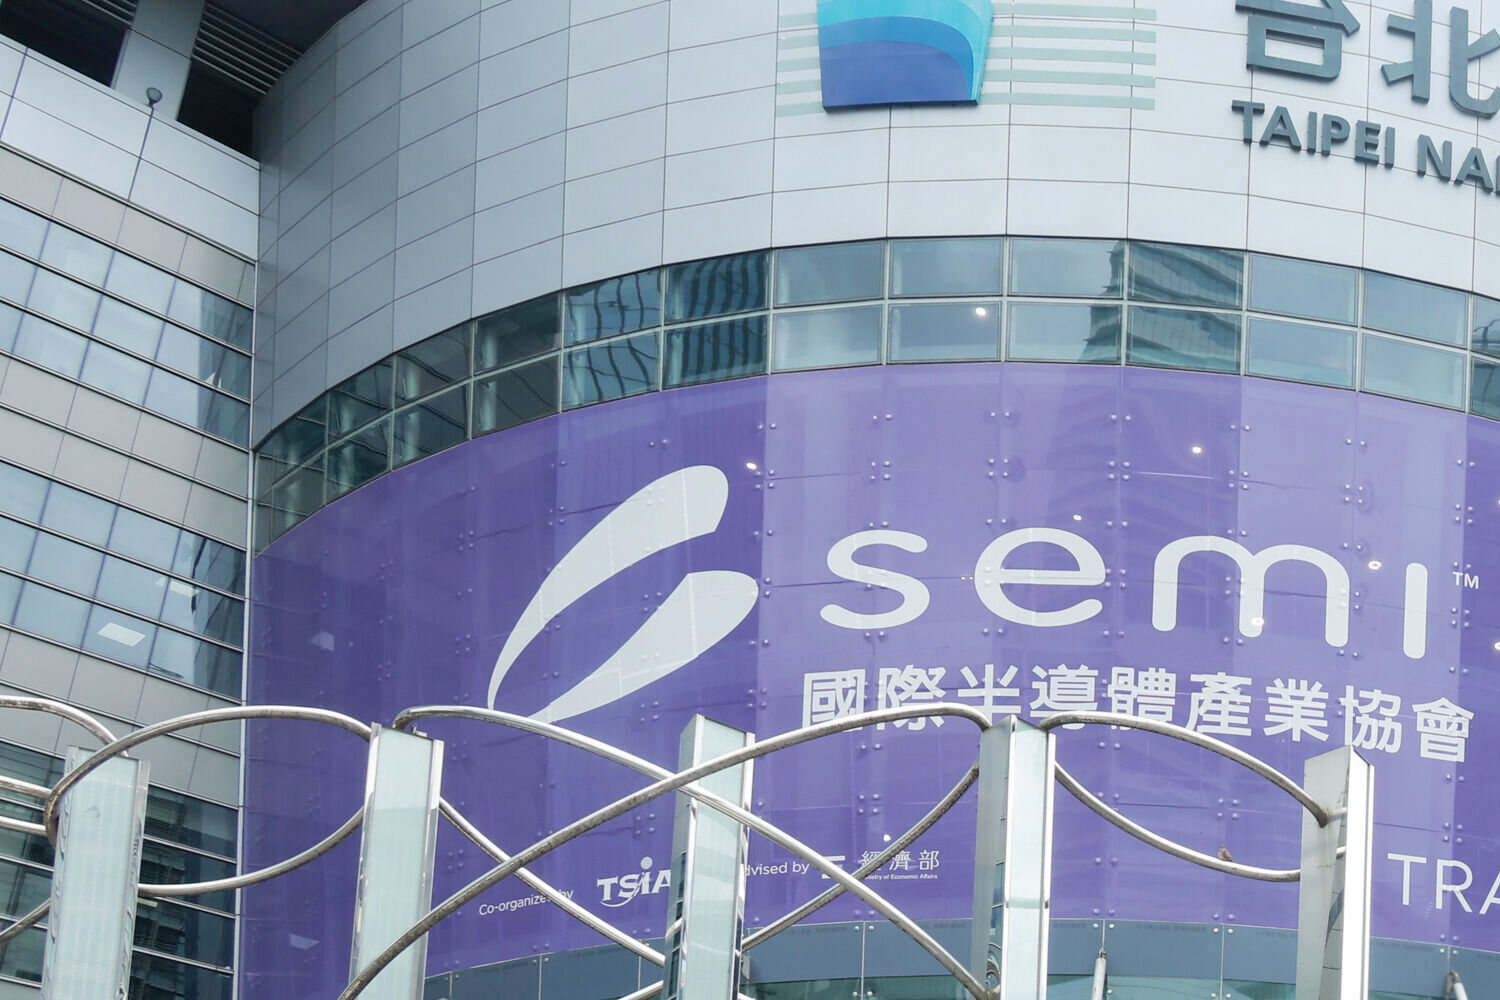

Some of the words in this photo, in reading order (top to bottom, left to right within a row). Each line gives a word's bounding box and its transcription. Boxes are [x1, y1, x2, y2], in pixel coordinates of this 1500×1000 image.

[1232, 100, 1396, 168] TAIPEI
[802, 664, 1475, 763] 國際半導體產業協會
[746, 861, 787, 876] dvised
[793, 861, 810, 875] by
[479, 892, 550, 916] Co-organize
